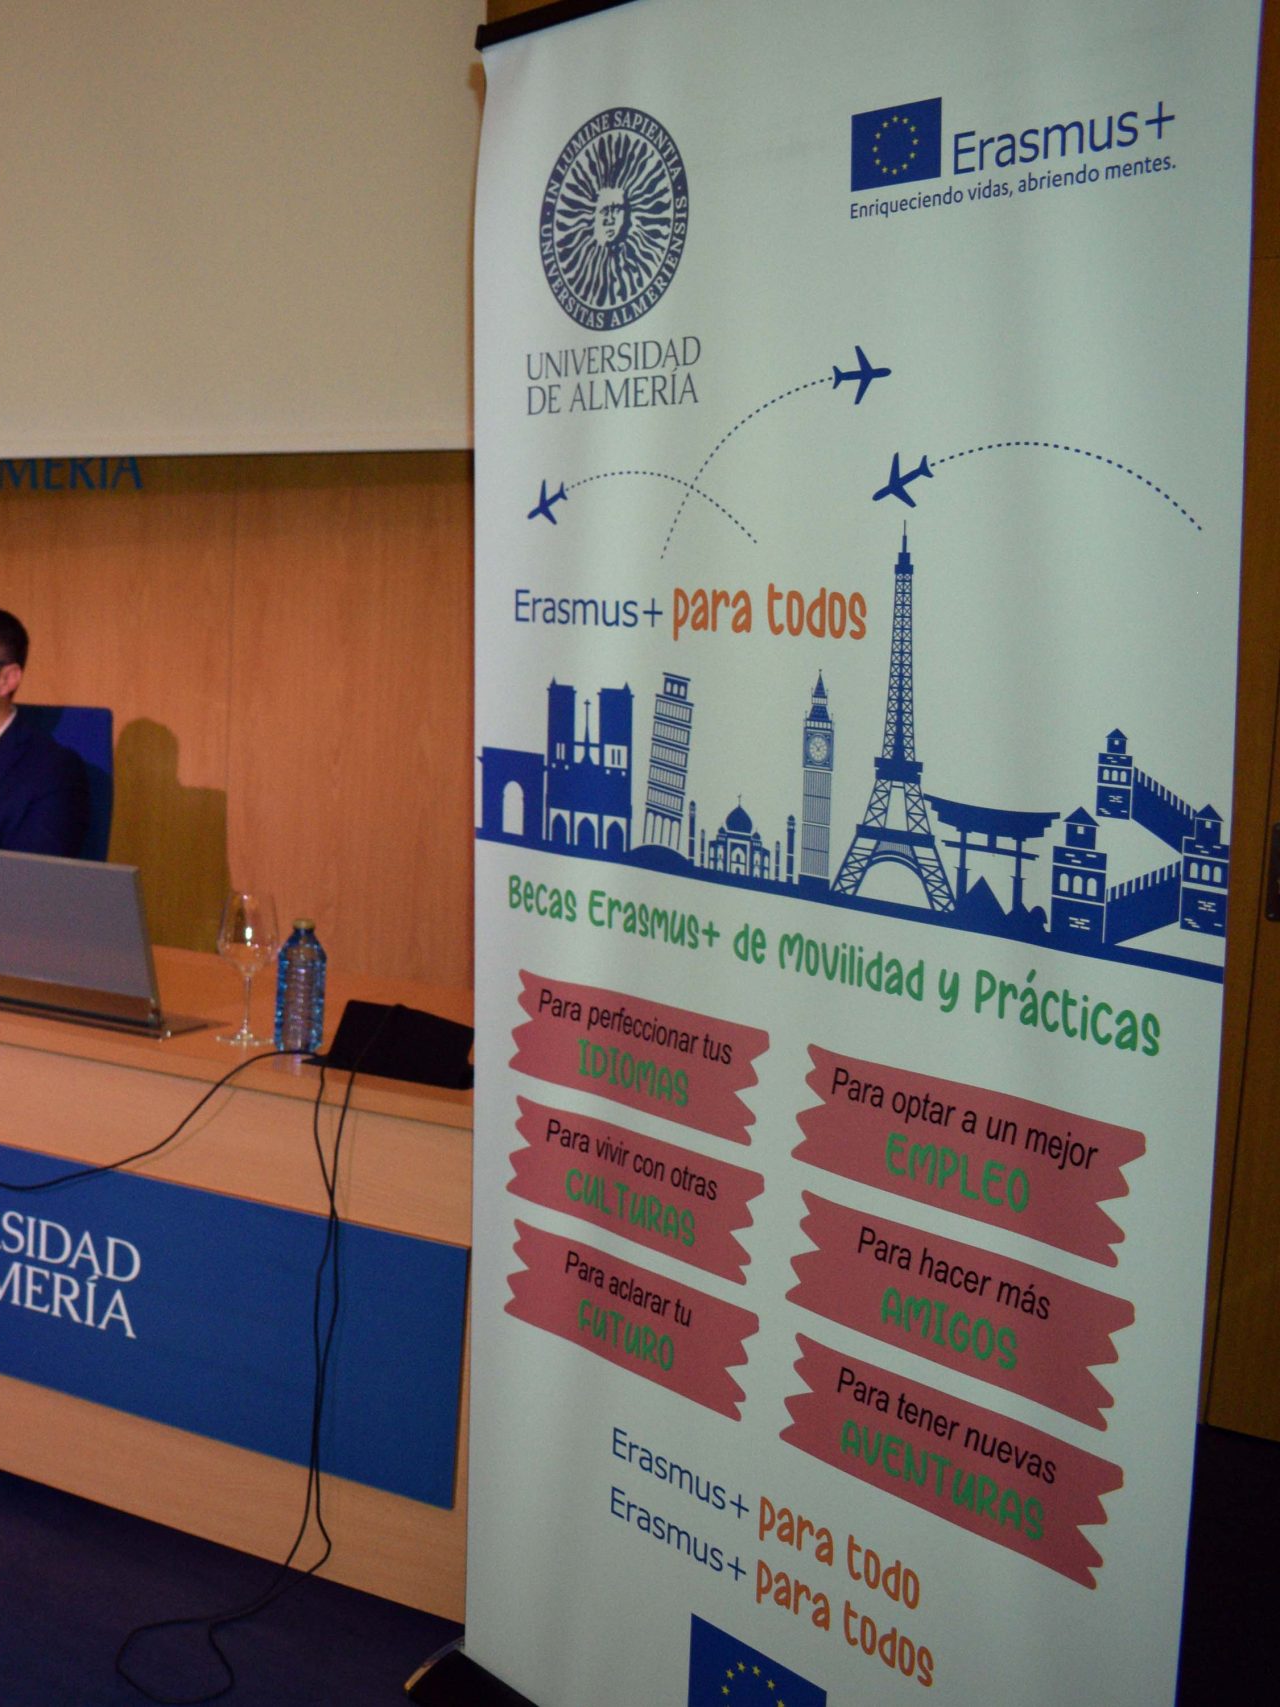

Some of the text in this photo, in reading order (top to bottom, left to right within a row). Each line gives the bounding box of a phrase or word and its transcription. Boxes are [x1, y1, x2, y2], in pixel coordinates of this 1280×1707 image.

[558, 112, 610, 174] LUMINE
[613, 110, 685, 181] SAPIENTIA
[953, 101, 1175, 176] Erasmus+
[850, 154, 1176, 219] Enriqueciendo vidas, abriendo mentes.
[540, 195, 688, 329] UNIVERSITAS ALMERIENSIS
[526, 335, 702, 382] UNIVERSIDAD
[526, 366, 700, 416] DE ALMERÍA
[514, 583, 868, 641] Erasmus+ para todos
[507, 874, 1162, 1058] Becas Erasmus+ de Movilidad y Prácticas
[538, 988, 734, 1065] Para perfeccionar tus
[577, 1038, 690, 1107] IDIOMAS
[546, 1118, 719, 1202] Para vivir con otras
[831, 1067, 1100, 1172] Para optar a un mejor
[564, 1168, 696, 1248] CULTURAS
[884, 1132, 1031, 1214] EMPLEO
[564, 1249, 693, 1328] Para aclarar tu
[856, 1225, 1052, 1321] Para hacer más
[577, 1299, 675, 1372] FUTURO
[880, 1287, 1019, 1371] AMIGOS
[836, 1366, 1057, 1486] Para tener nuevas
[612, 1427, 921, 1610] Erasmus+ para todo
[841, 1419, 1045, 1542] AVENTURAS
[610, 1486, 934, 1687] Erasmus+ para todos
